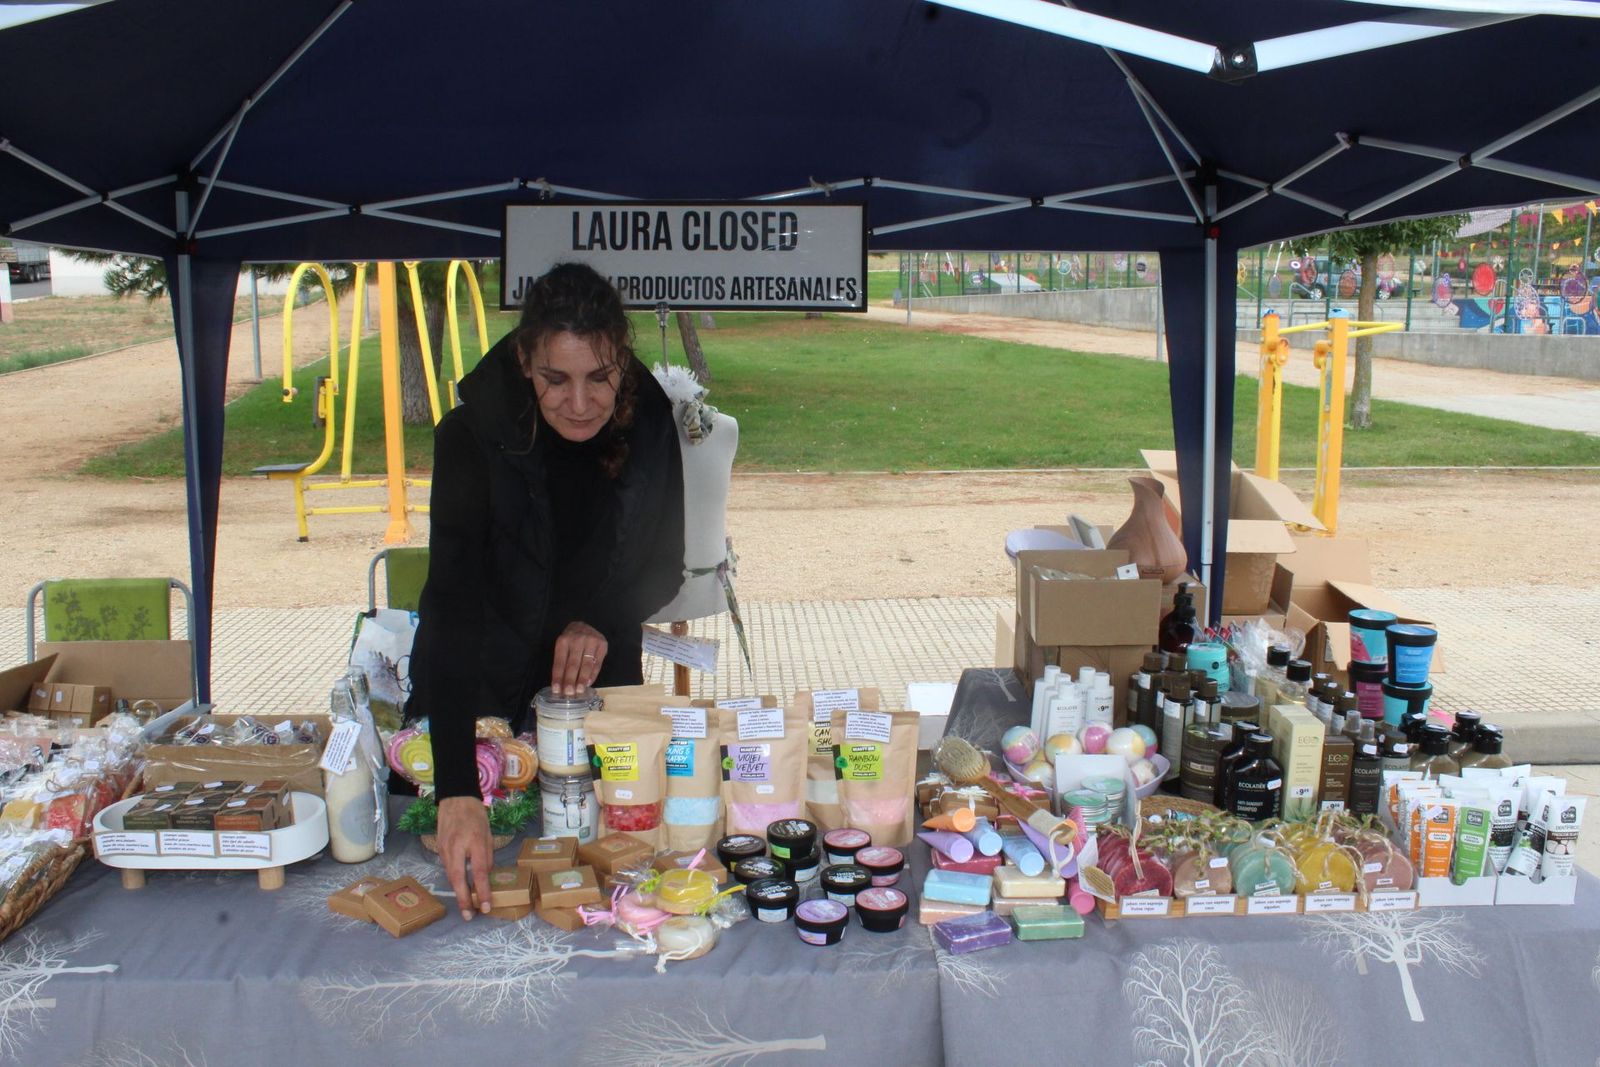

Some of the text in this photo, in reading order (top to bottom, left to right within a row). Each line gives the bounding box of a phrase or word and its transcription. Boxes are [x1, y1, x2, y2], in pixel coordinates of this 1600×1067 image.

[572, 211, 798, 251] LAURA CLOSED
[620, 276, 857, 300] PRODUCTOS ARTESANALES
[814, 729, 831, 737] CAN
[603, 756, 635, 764] CONFETTI
[738, 754, 760, 763] VIOLET
[736, 763, 767, 772] VELVET
